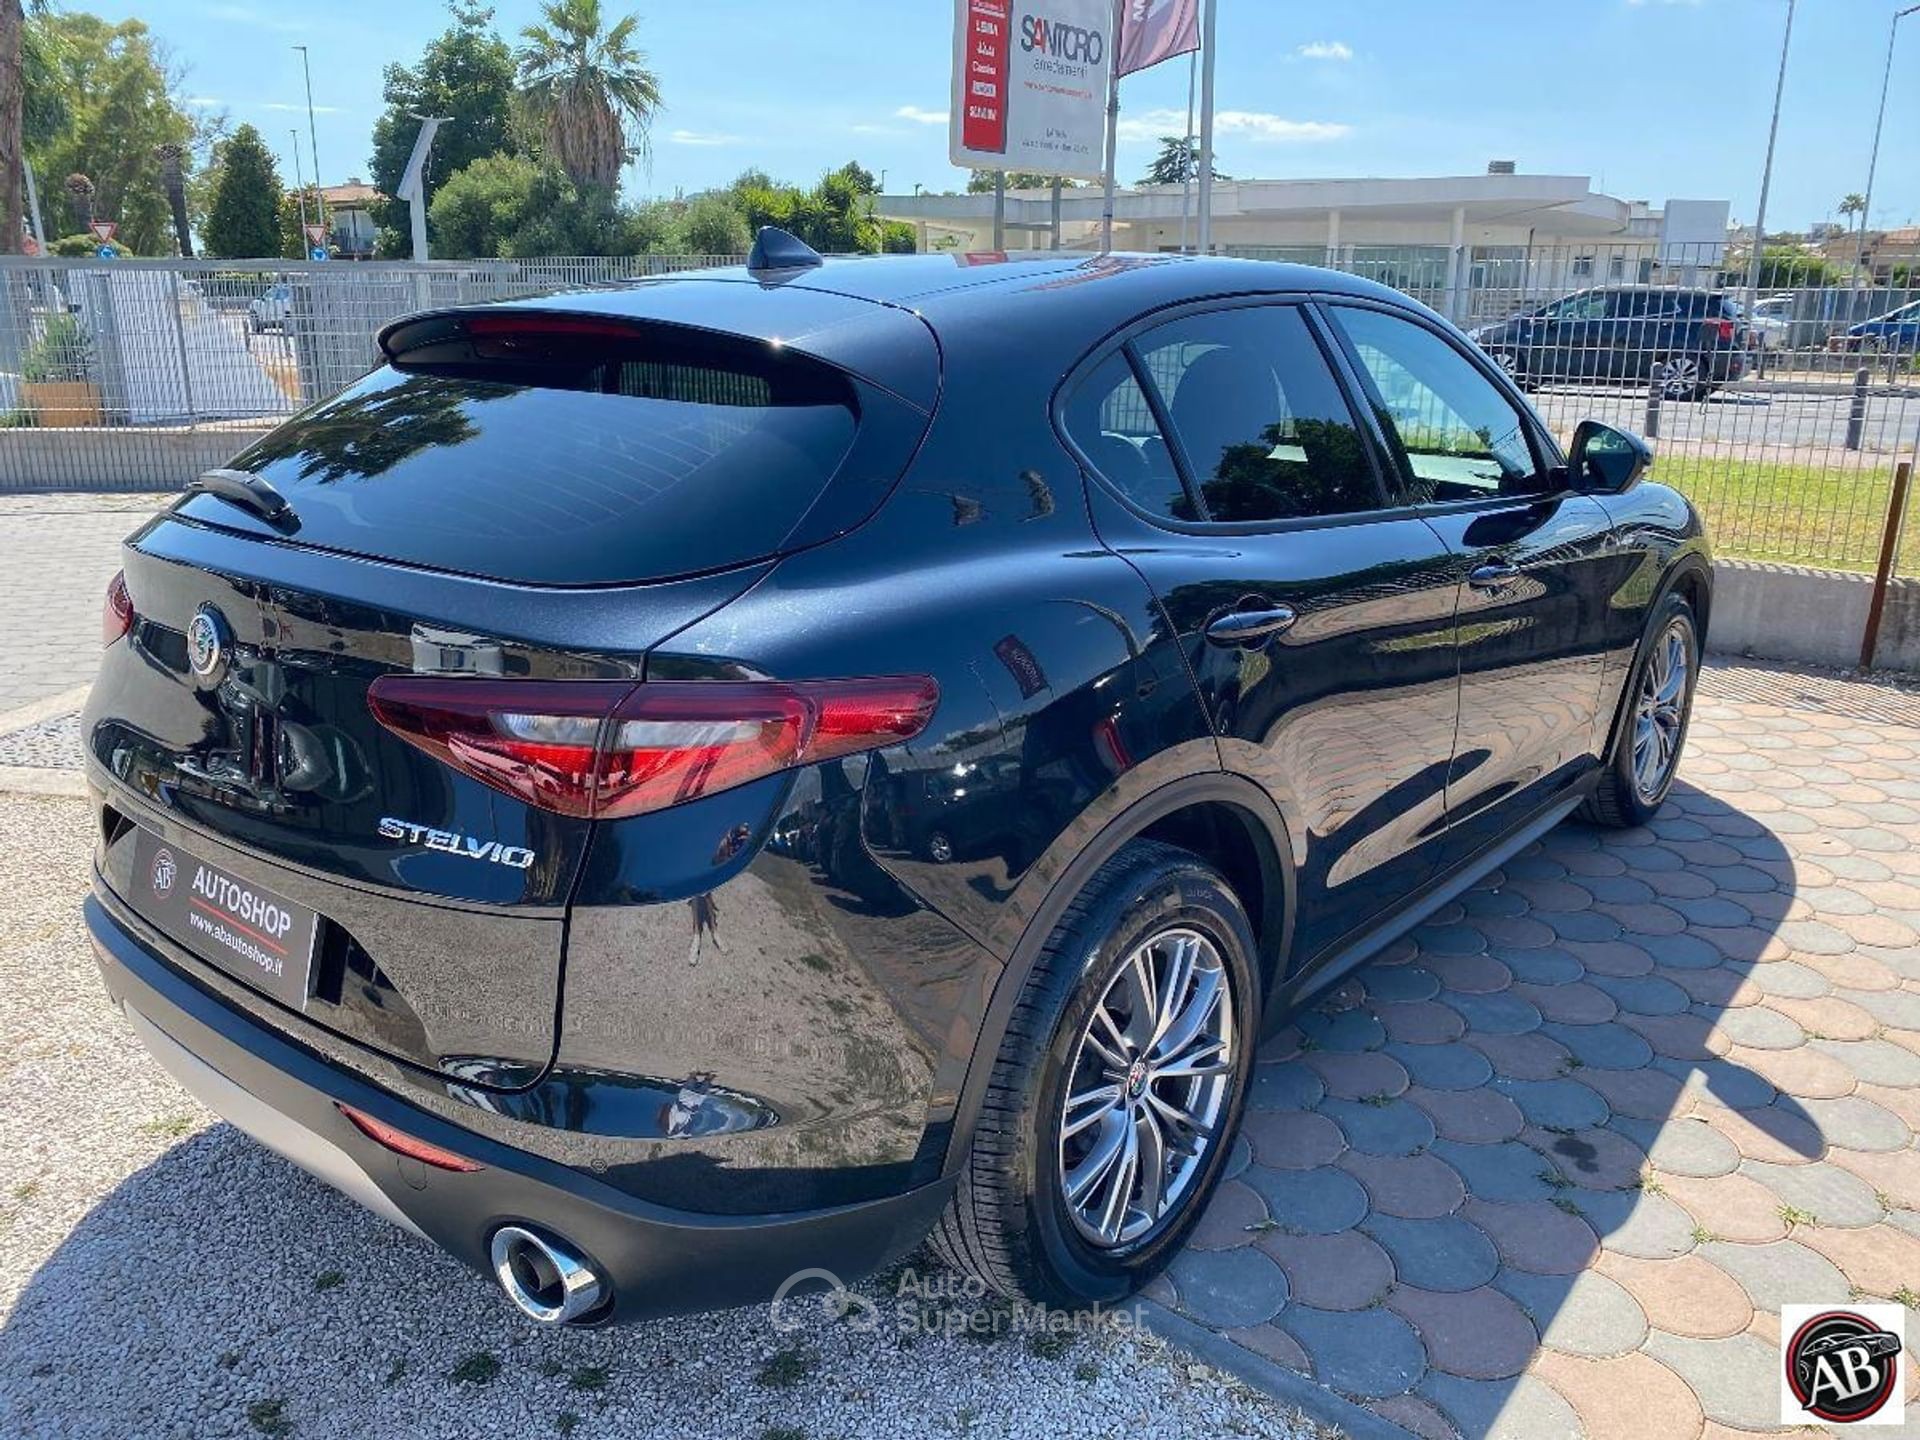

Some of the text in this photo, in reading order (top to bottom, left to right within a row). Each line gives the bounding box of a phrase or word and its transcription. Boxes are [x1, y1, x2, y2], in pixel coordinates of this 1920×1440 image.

[378, 817, 536, 868] STELVIO
[191, 865, 291, 938] AUTOSHOP
[189, 911, 283, 977] www.abautoshop.it
